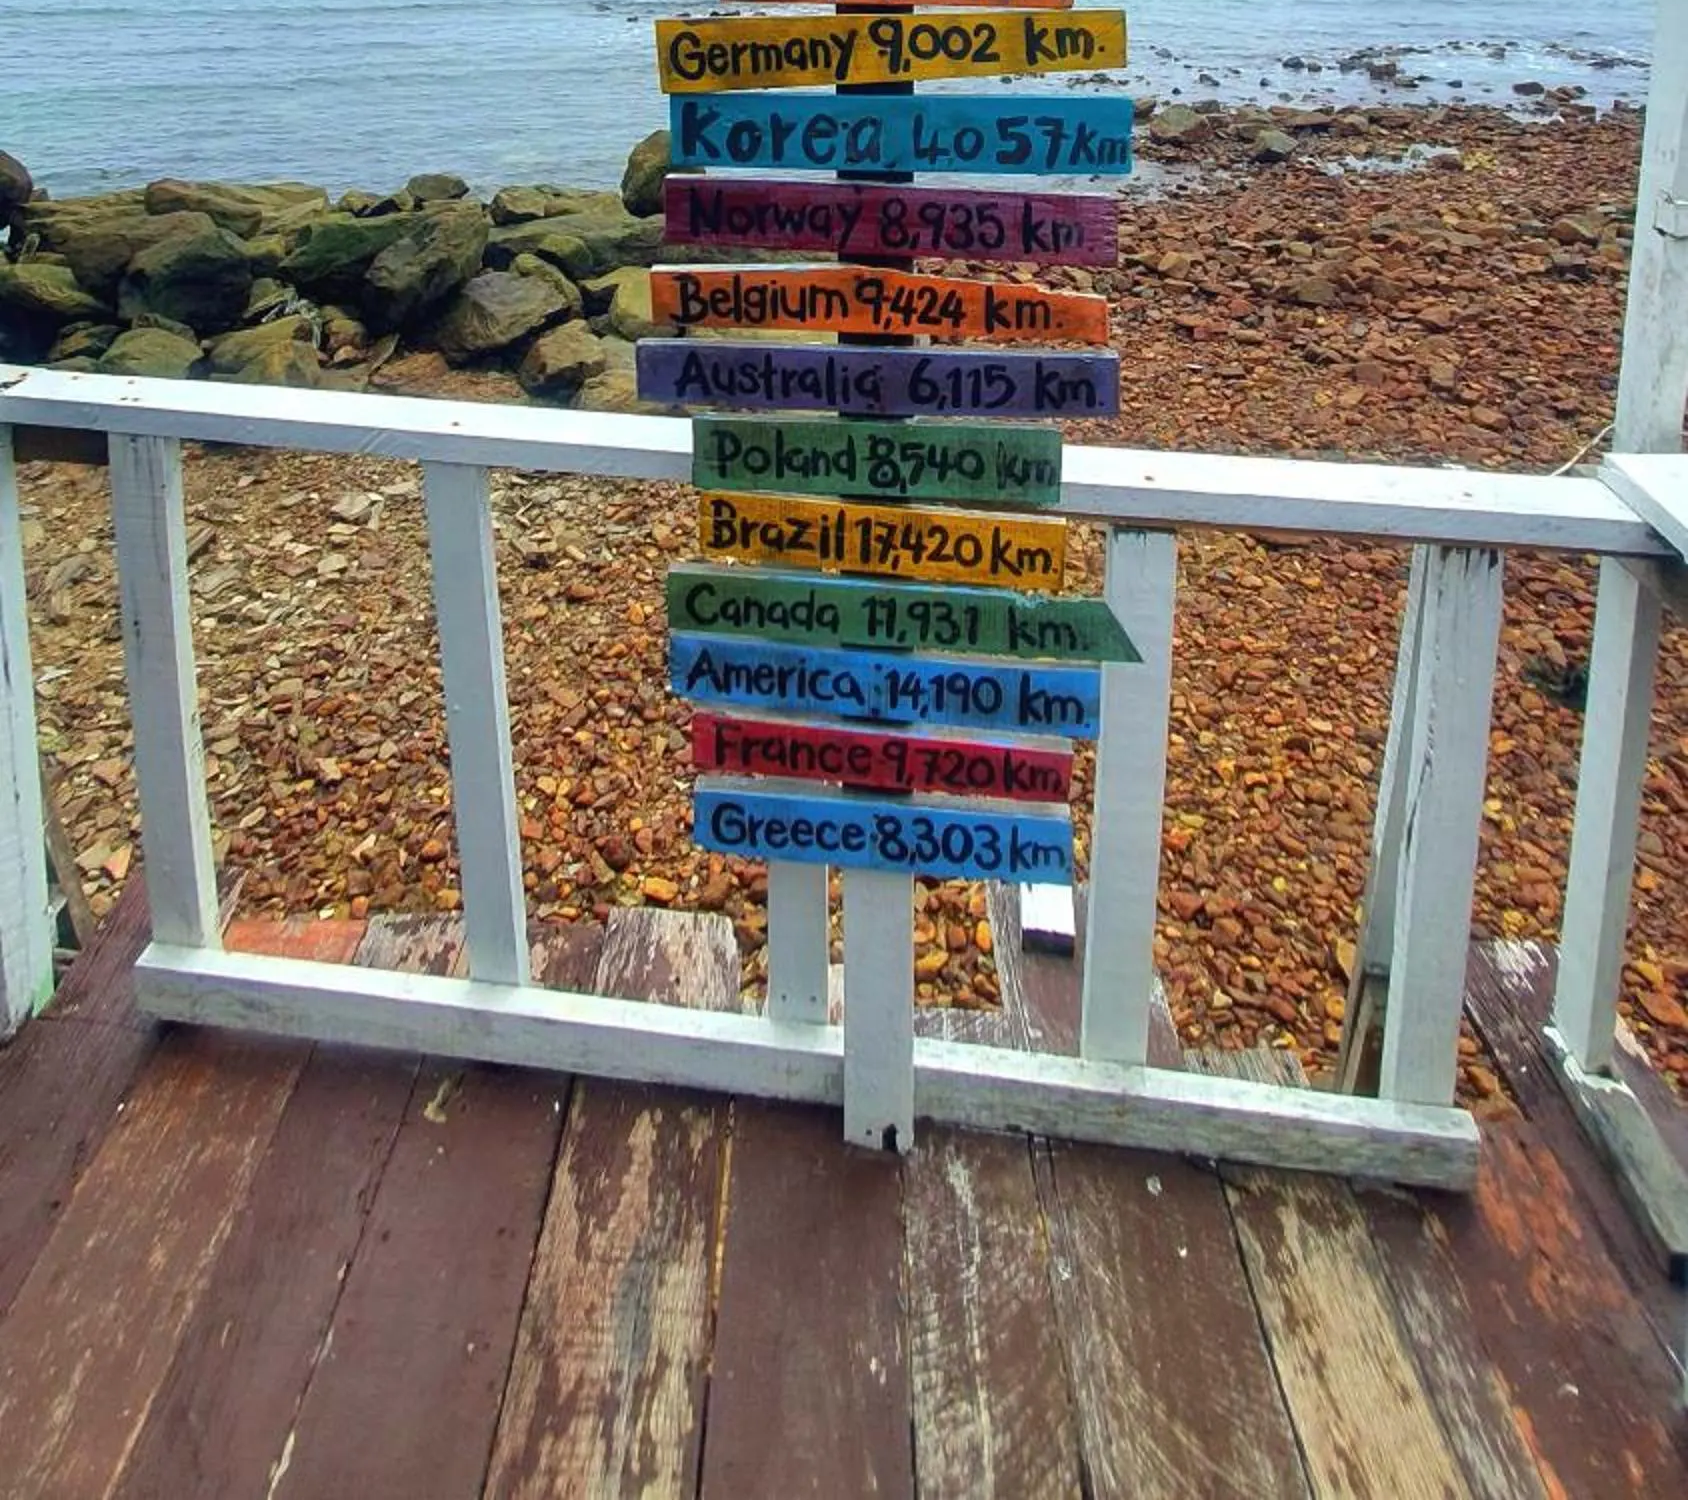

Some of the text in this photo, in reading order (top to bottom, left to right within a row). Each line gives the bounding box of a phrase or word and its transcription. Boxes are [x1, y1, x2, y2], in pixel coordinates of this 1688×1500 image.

[670, 17, 1106, 80] Germany 9,002 km.
[688, 188, 862, 248] Norway
[880, 197, 1006, 252] 8,935
[670, 274, 1064, 333] Belgium 9,424 km.
[674, 351, 882, 406] Australia
[909, 357, 1016, 409] 6,115
[710, 429, 856, 481] Poland
[707, 498, 1058, 577] Brazil 17,420 km.
[686, 583, 1089, 651] Canada 11,931 km.
[1018, 674, 1091, 728] km.
[713, 724, 873, 774] France
[882, 742, 996, 787] 9,720
[711, 802, 866, 852] Greece
